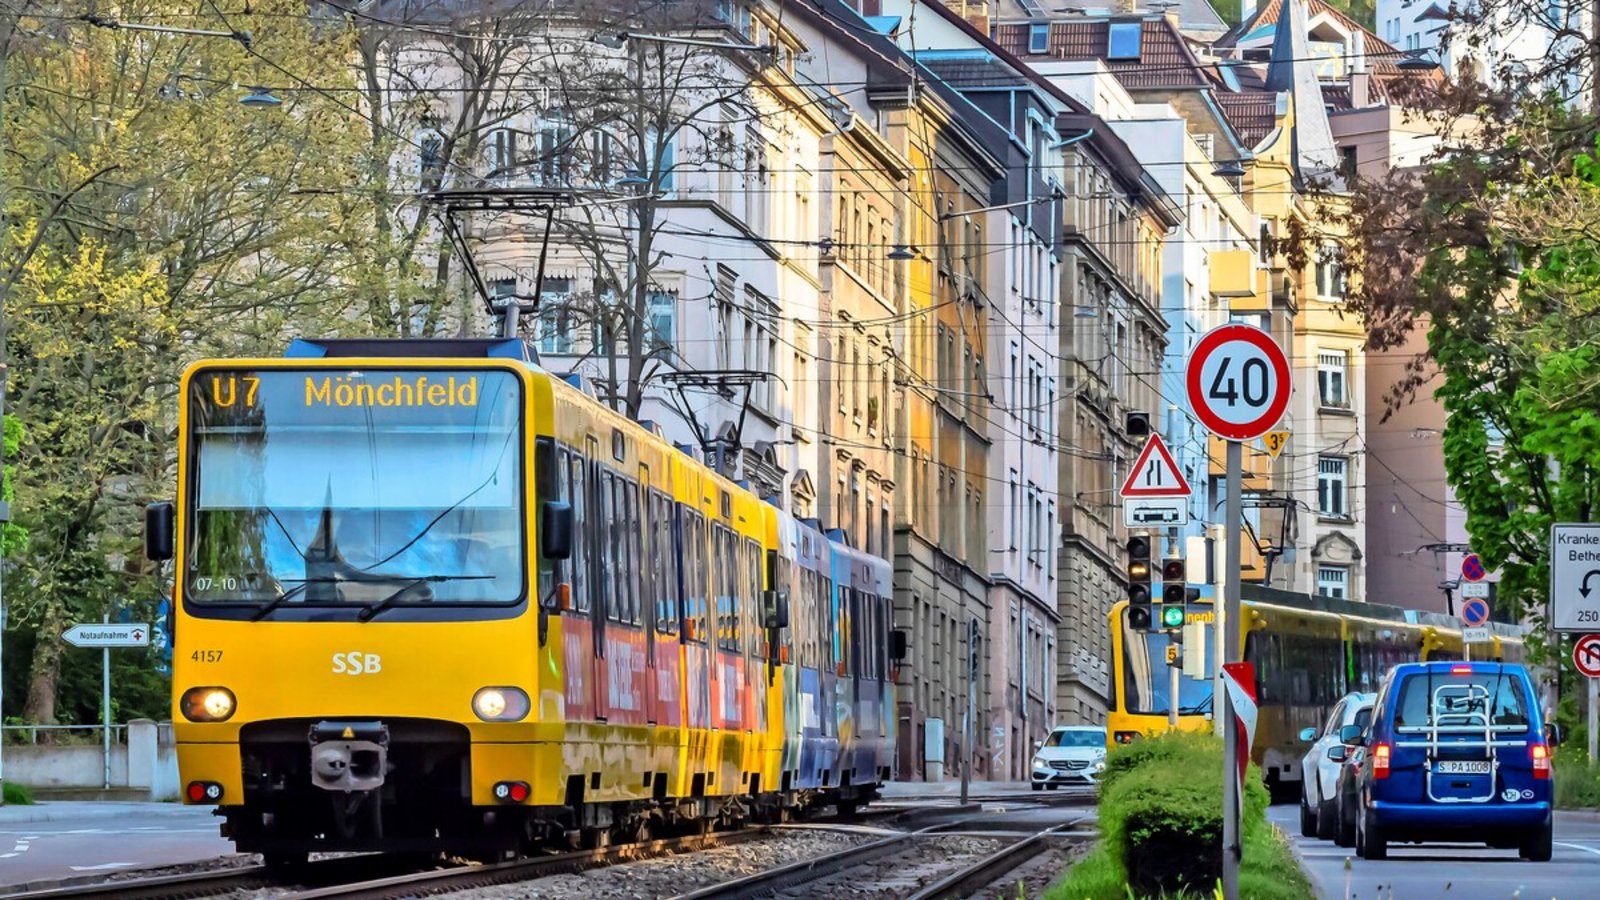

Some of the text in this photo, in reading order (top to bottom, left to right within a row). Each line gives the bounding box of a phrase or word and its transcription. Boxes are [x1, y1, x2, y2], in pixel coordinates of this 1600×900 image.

[1209, 357, 1269, 408] 40
[212, 376, 478, 407] U7 Mönchfeld
[1558, 533, 1600, 545] Kranke
[196, 578, 237, 591] 07-10
[1577, 610, 1599, 622] 250
[80, 631, 128, 640] Notaufnahme
[191, 650, 224, 662] 4157
[1168, 648, 1177, 661] 5
[331, 652, 382, 675] SSB
